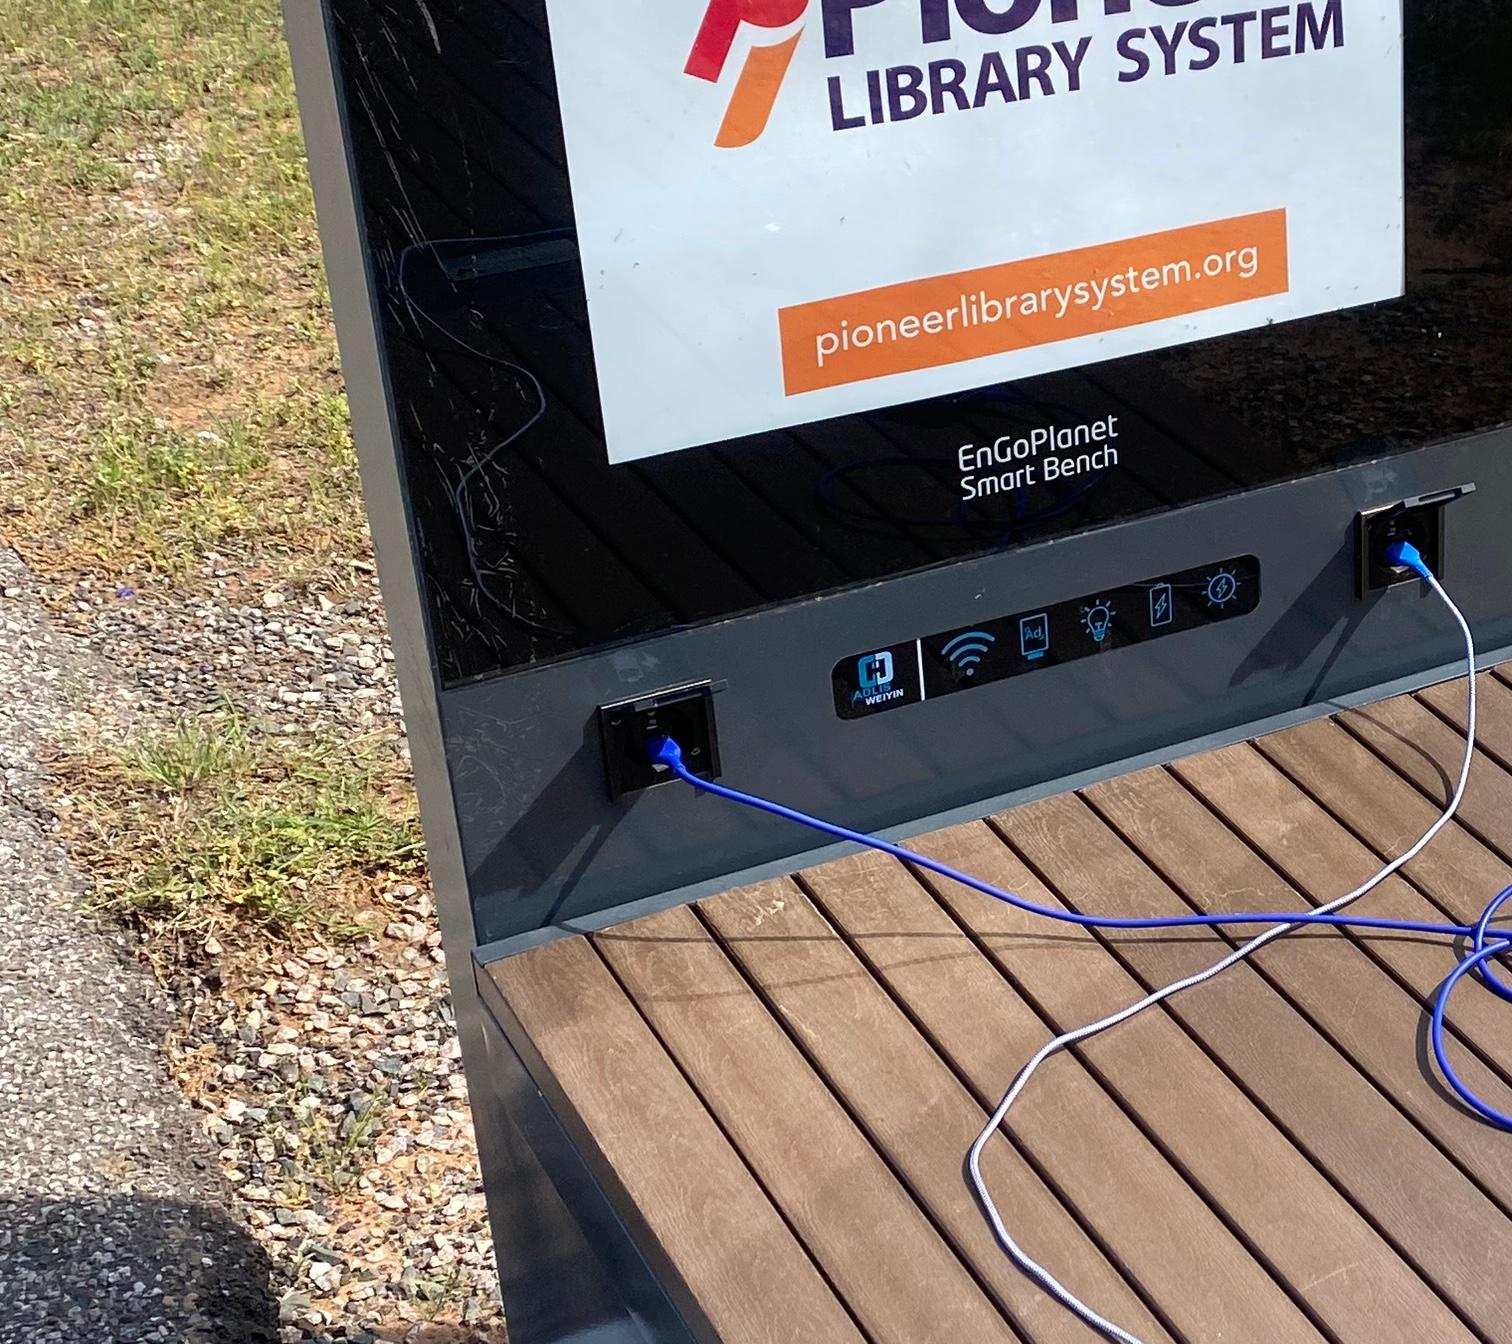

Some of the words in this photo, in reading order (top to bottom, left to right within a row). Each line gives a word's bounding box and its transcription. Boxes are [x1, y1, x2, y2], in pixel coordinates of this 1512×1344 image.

[828, 36, 1092, 131] LIBRARY
[817, 247, 1257, 367] pioneerlibrarysystem.org
[959, 415, 1118, 471] EnGoPlanet
[961, 465, 1035, 500] Smart
[1044, 444, 1117, 480] Bench
[854, 683, 892, 701] ADLIS
[865, 689, 904, 706] WEIYIN
